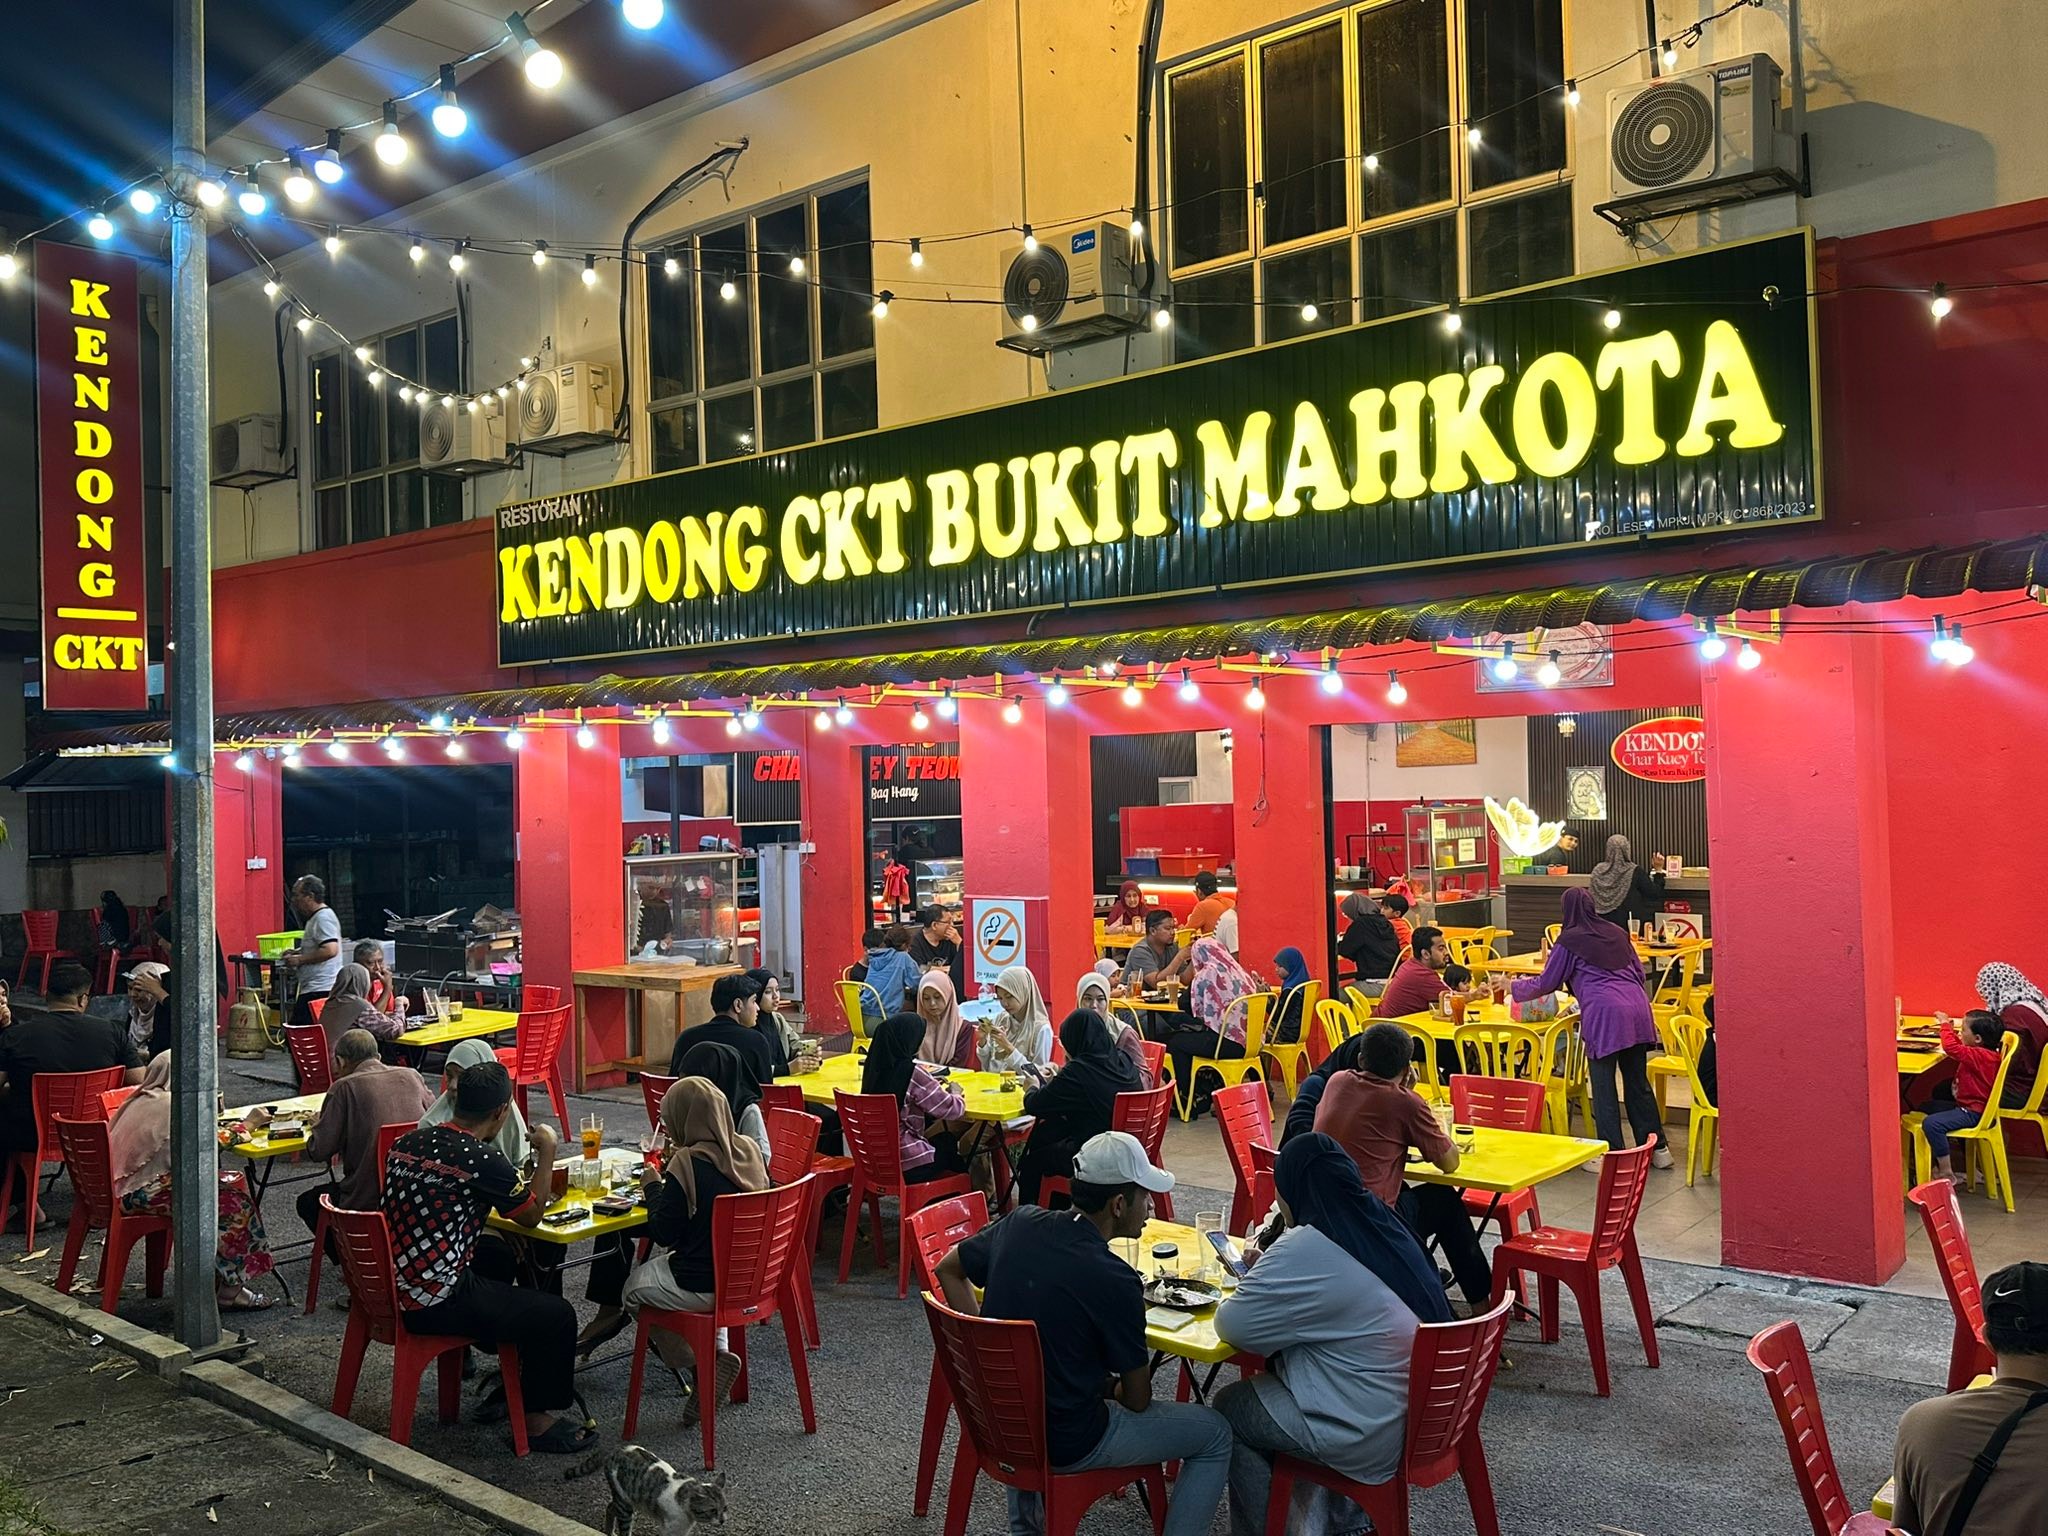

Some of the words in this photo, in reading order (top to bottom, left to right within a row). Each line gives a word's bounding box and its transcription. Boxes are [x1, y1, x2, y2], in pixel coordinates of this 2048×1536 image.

[1718, 66, 1750, 79] TOPAIRE
[70, 279, 116, 598] KENDONG
[498, 506, 768, 624] KENDONG
[780, 476, 913, 584] CKT
[926, 428, 1179, 567] BUKIT
[1196, 318, 1784, 529] MAHKOTA
[501, 496, 581, 529] RESTORAN
[1616, 520, 1655, 534] LESEN
[53, 634, 143, 671] CKT
[1622, 752, 1655, 766] Char
[1656, 752, 1689, 768] Kuey
[891, 785, 920, 802] Hang
